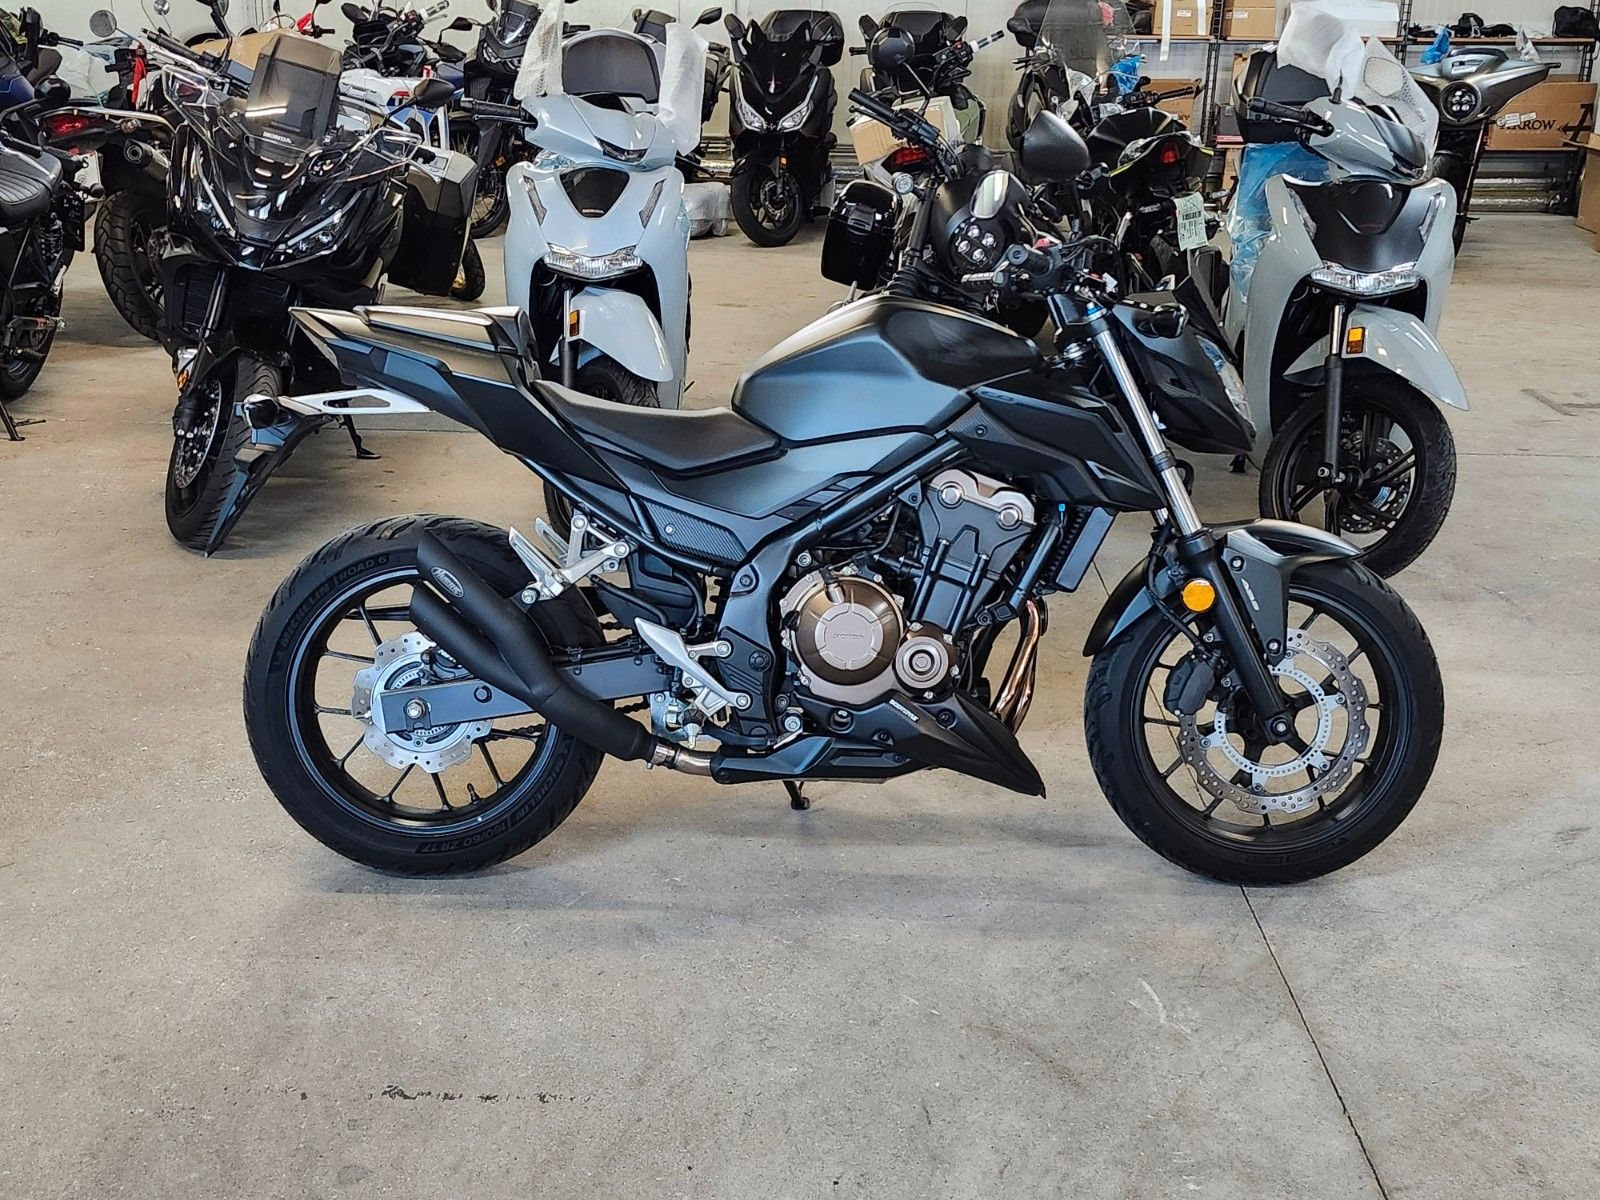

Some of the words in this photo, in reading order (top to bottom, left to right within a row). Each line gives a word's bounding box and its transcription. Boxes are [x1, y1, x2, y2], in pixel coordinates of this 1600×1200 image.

[262, 131, 292, 144] HONDA
[281, 582, 331, 648] MICHELIN
[337, 559, 375, 580] ROAD
[377, 555, 387, 565] 6
